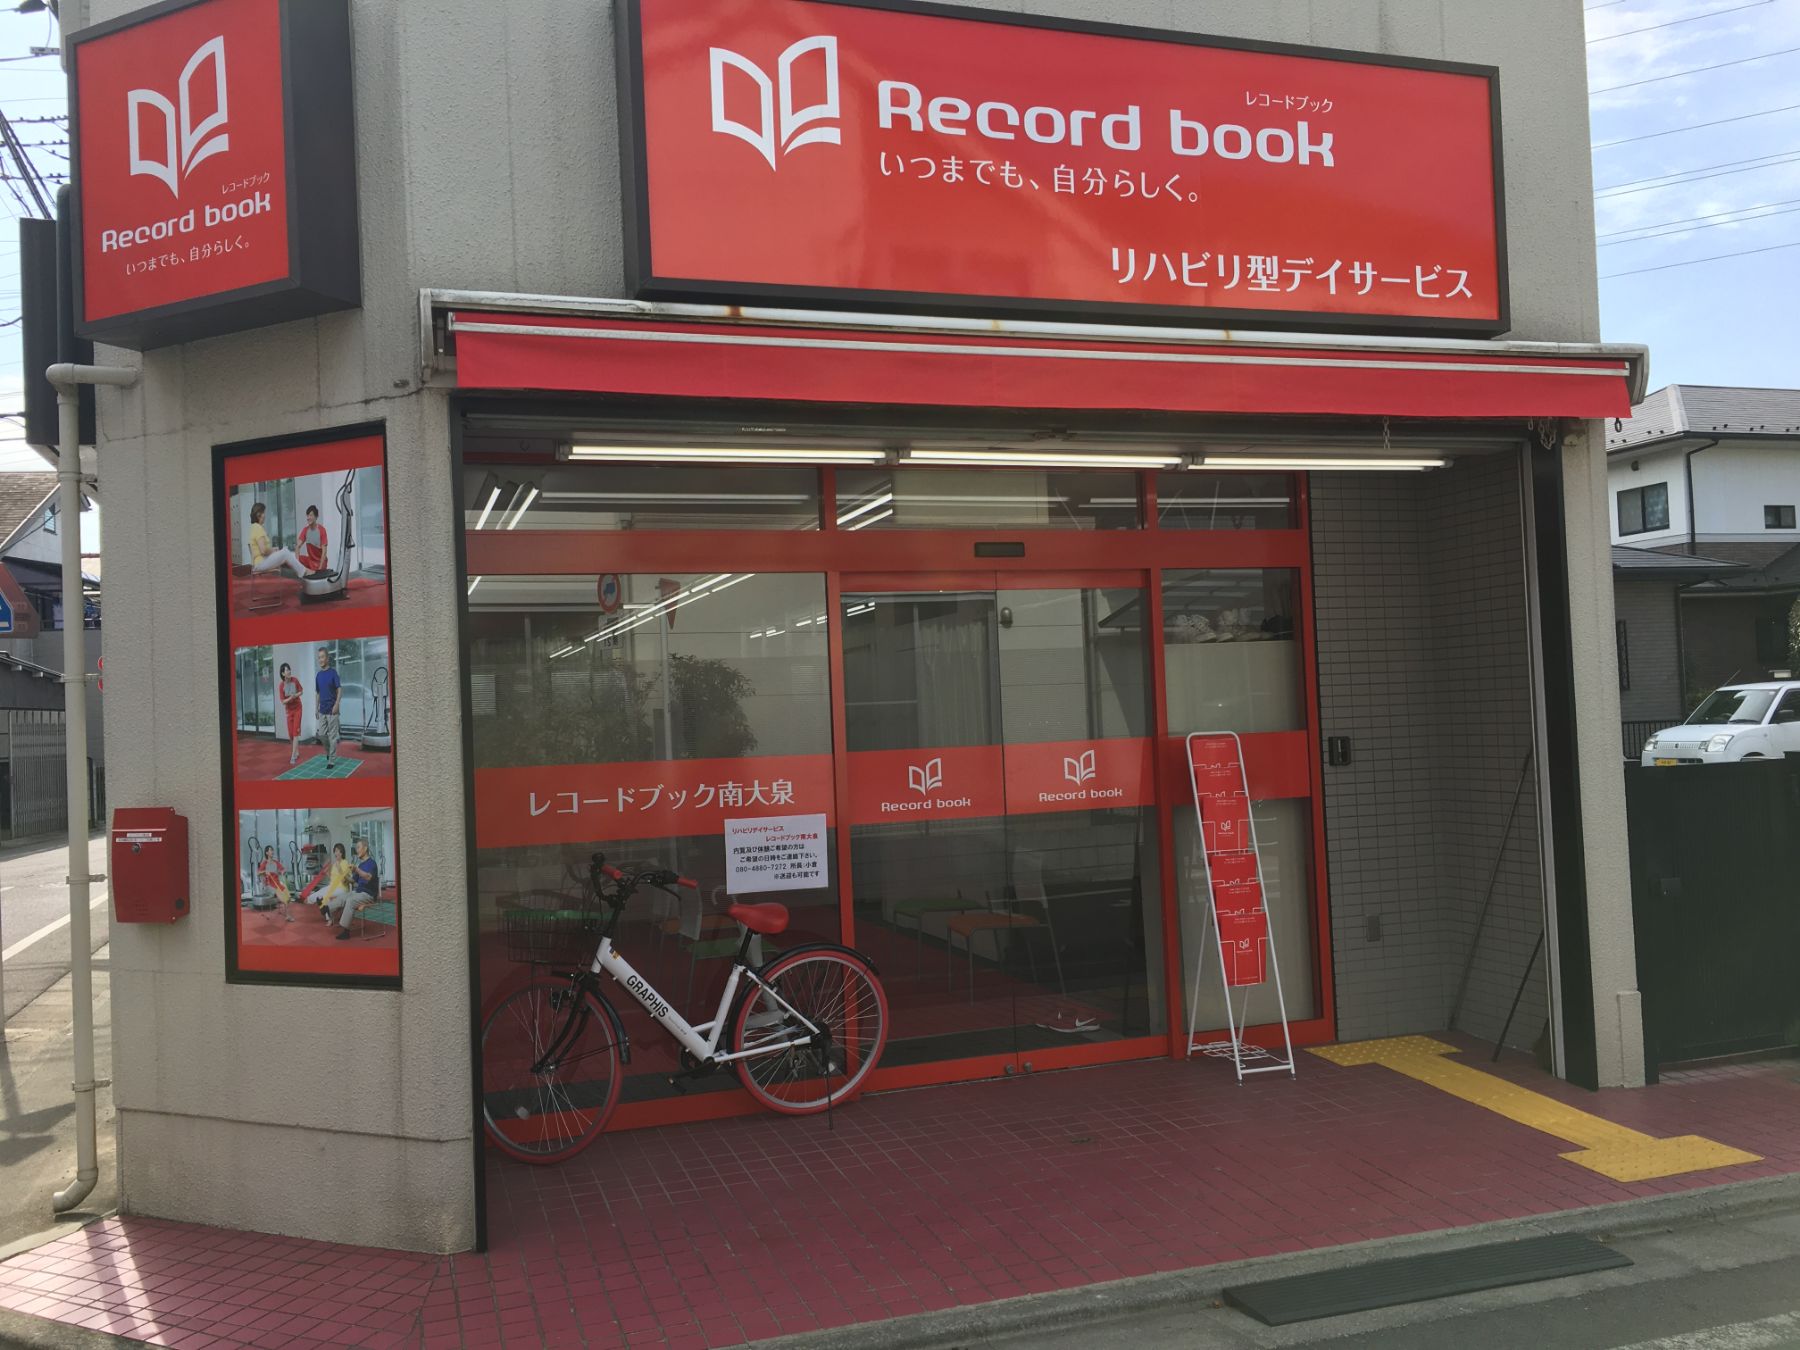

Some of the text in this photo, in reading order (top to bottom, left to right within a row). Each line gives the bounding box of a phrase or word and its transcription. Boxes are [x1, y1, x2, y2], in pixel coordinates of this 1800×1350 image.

[1244, 90, 1334, 114] レコードブック
[877, 79, 1336, 168] Record book
[222, 171, 271, 195] レコードブック
[879, 150, 1199, 203] いつまでも、自分らしく。
[102, 191, 272, 253] Record book
[126, 234, 250, 276] いつまでも、自分らしく。
[1112, 247, 1473, 299] リハビリ型デイサービス
[529, 778, 796, 817] レコードブック南大泉
[881, 797, 971, 812] Record book
[1039, 787, 1123, 802] Record book
[626, 975, 669, 1018] GRAPHIS
